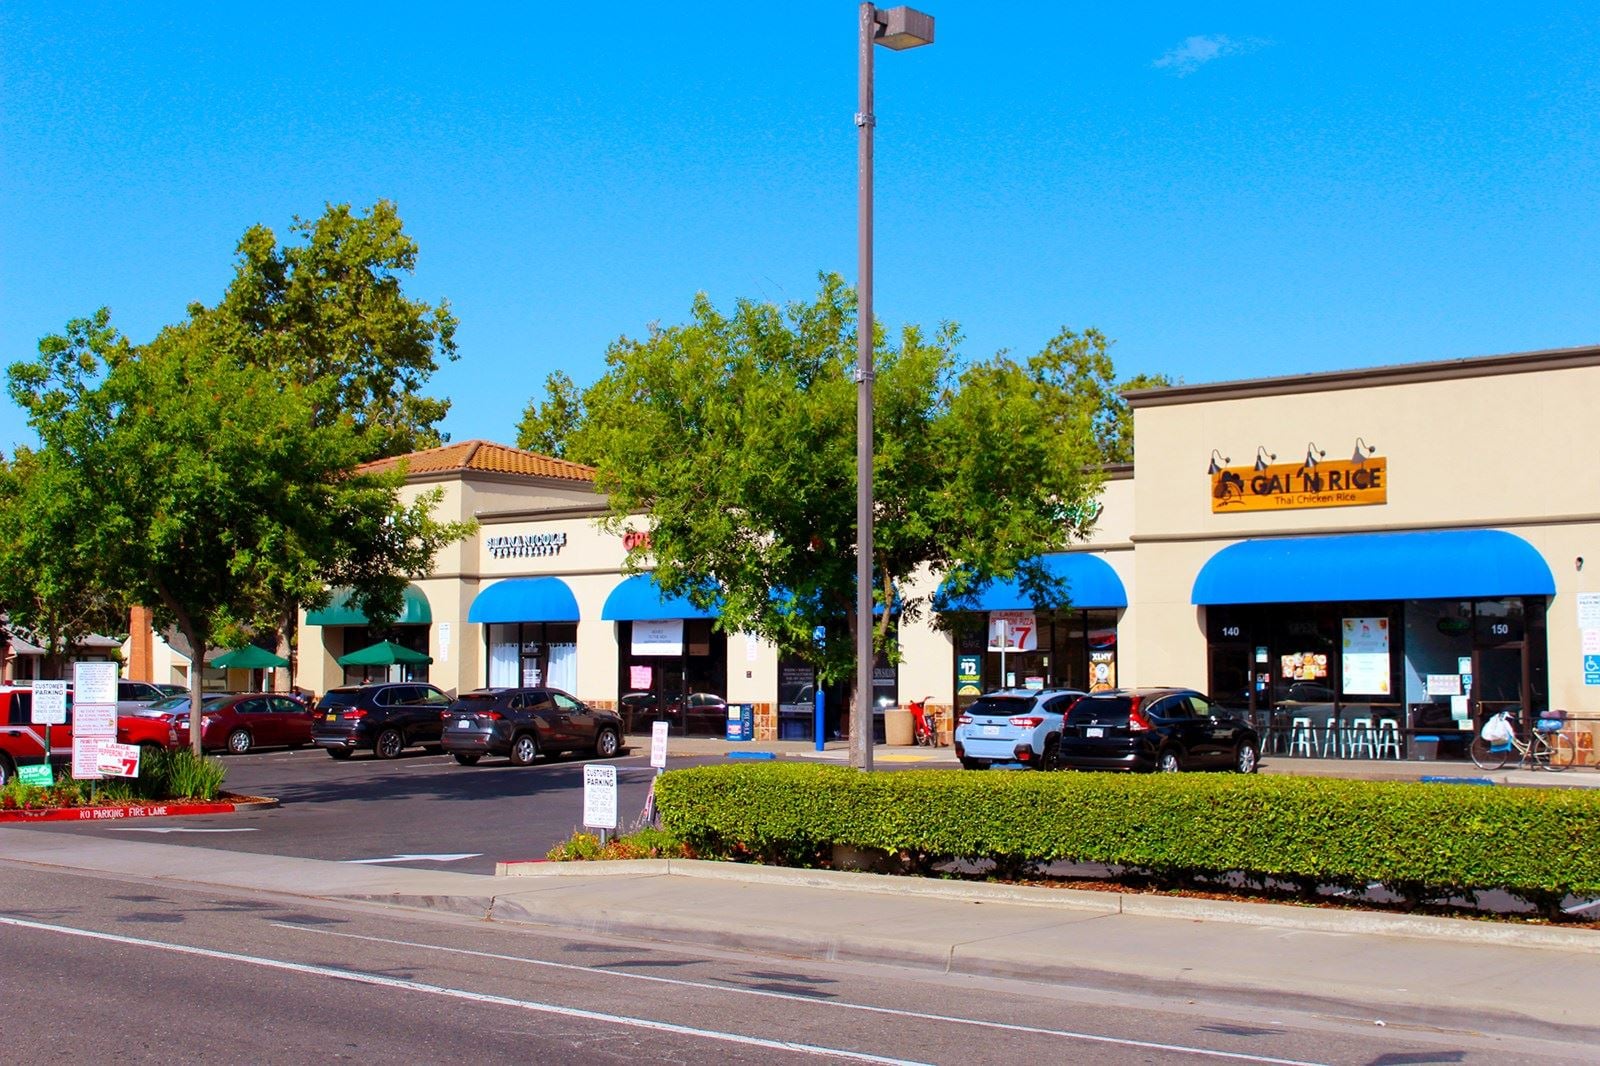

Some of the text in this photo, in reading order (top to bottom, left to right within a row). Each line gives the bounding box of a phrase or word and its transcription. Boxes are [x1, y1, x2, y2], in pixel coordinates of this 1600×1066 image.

[1251, 474, 1290, 495] GAI
[1329, 468, 1381, 490] RICE
[1275, 493, 1356, 505] Thai Chicken Rice
[1222, 626, 1240, 636] 140
[1491, 624, 1508, 634] 150
[586, 769, 613, 777] CUSTOMER
[586, 778, 614, 787] PARKING
[79, 806, 168, 819] NO PARKING FIRE LANE
